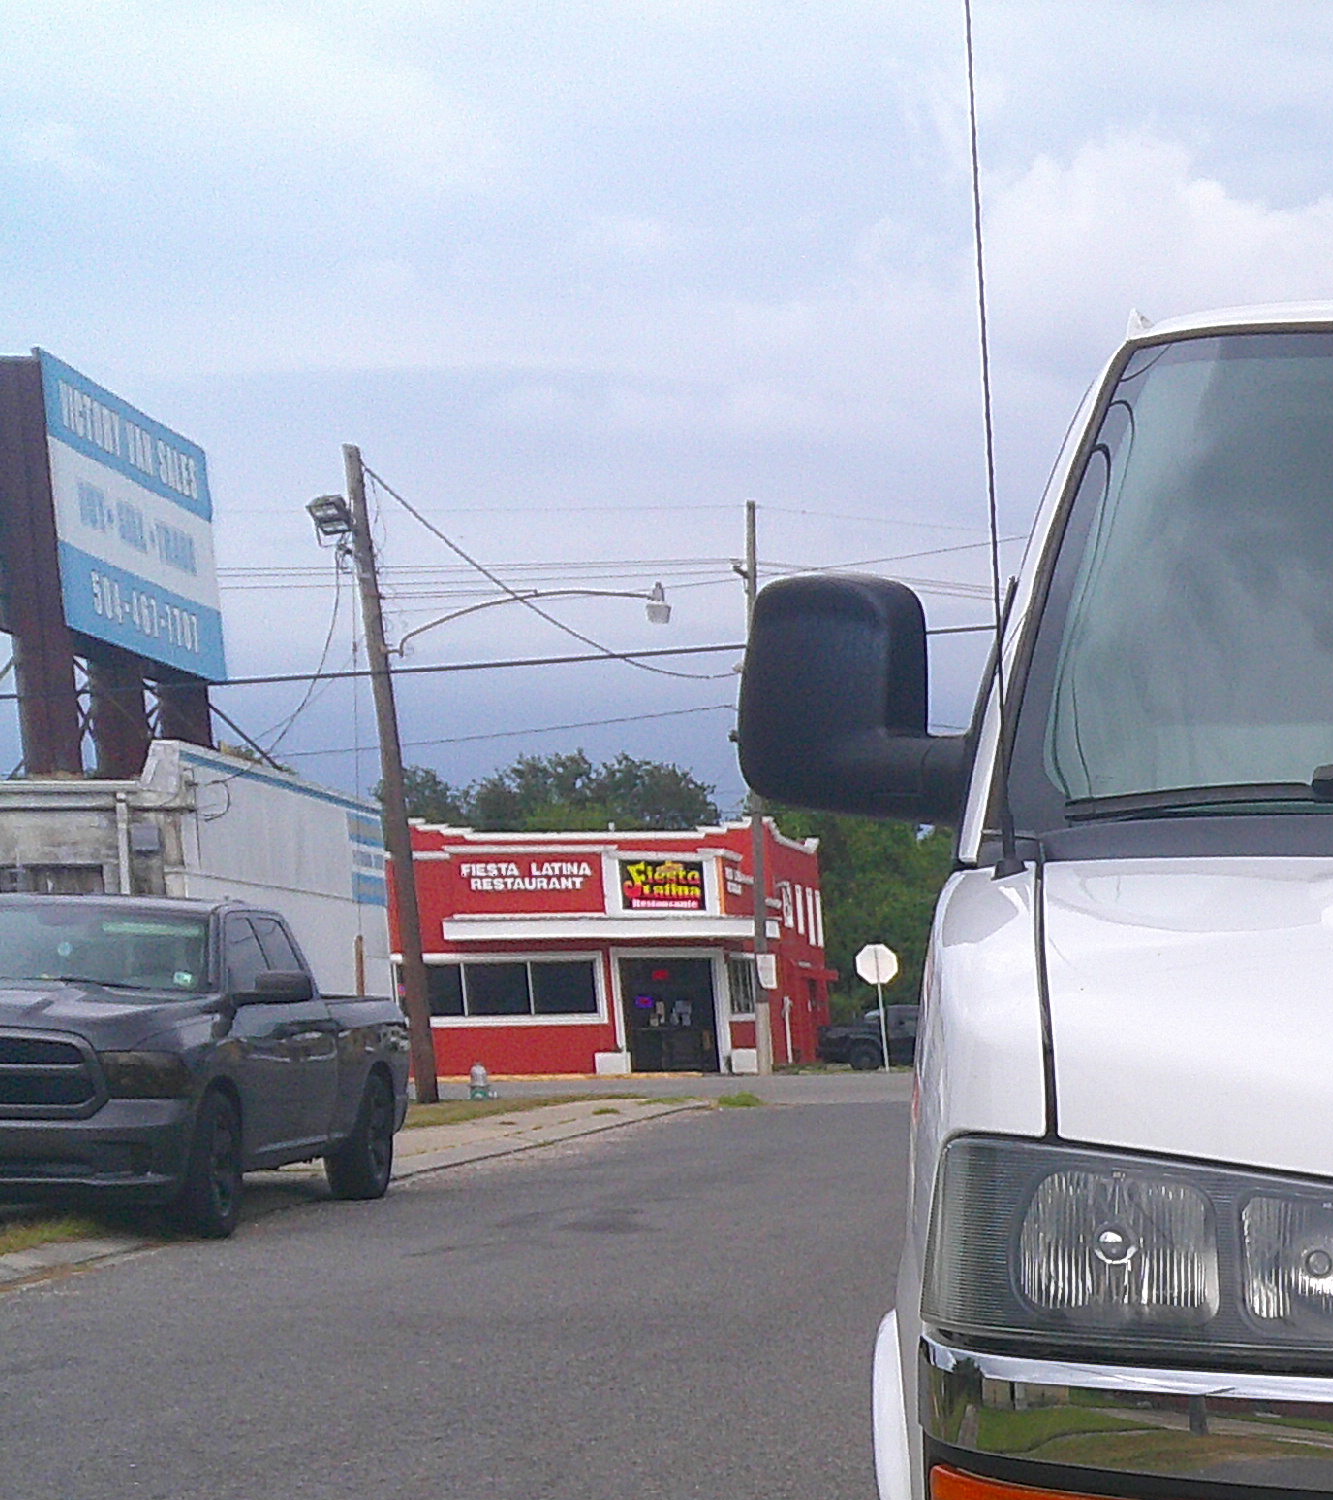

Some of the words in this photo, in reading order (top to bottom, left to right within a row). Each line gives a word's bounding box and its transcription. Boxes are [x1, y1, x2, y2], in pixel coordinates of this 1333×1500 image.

[157, 439, 198, 500] SALES
[460, 862, 519, 877] FIESTA
[530, 862, 592, 875] LATINA
[470, 877, 583, 891] RESTAURANT
